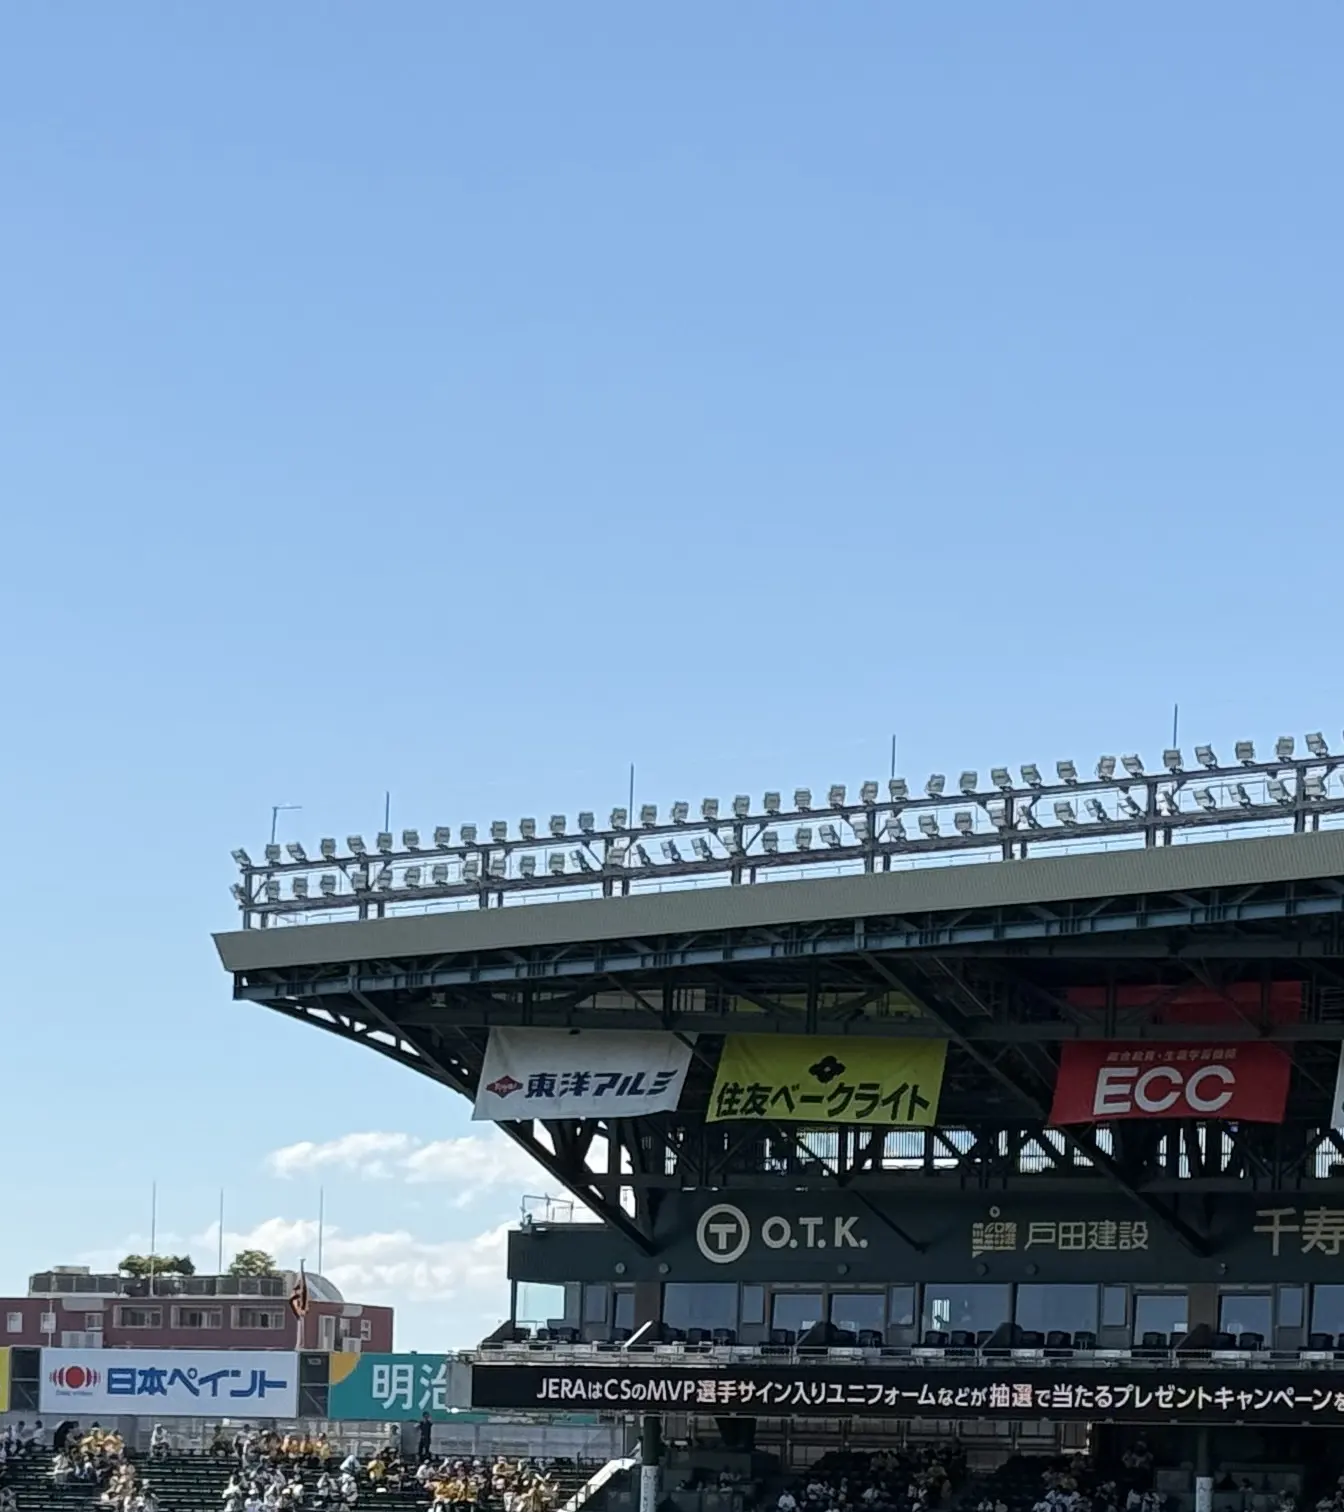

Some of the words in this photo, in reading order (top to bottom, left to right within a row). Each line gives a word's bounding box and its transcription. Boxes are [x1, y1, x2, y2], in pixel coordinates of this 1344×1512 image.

[526, 1069, 678, 1099] 東洋アルミ
[1093, 1066, 1234, 1115] ECC
[715, 1082, 931, 1122] 住友ベークライト
[761, 1216, 868, 1250] O.T.K.
[1024, 1220, 1148, 1251] 戸田建設
[106, 1366, 288, 1397] 日本ペイント
